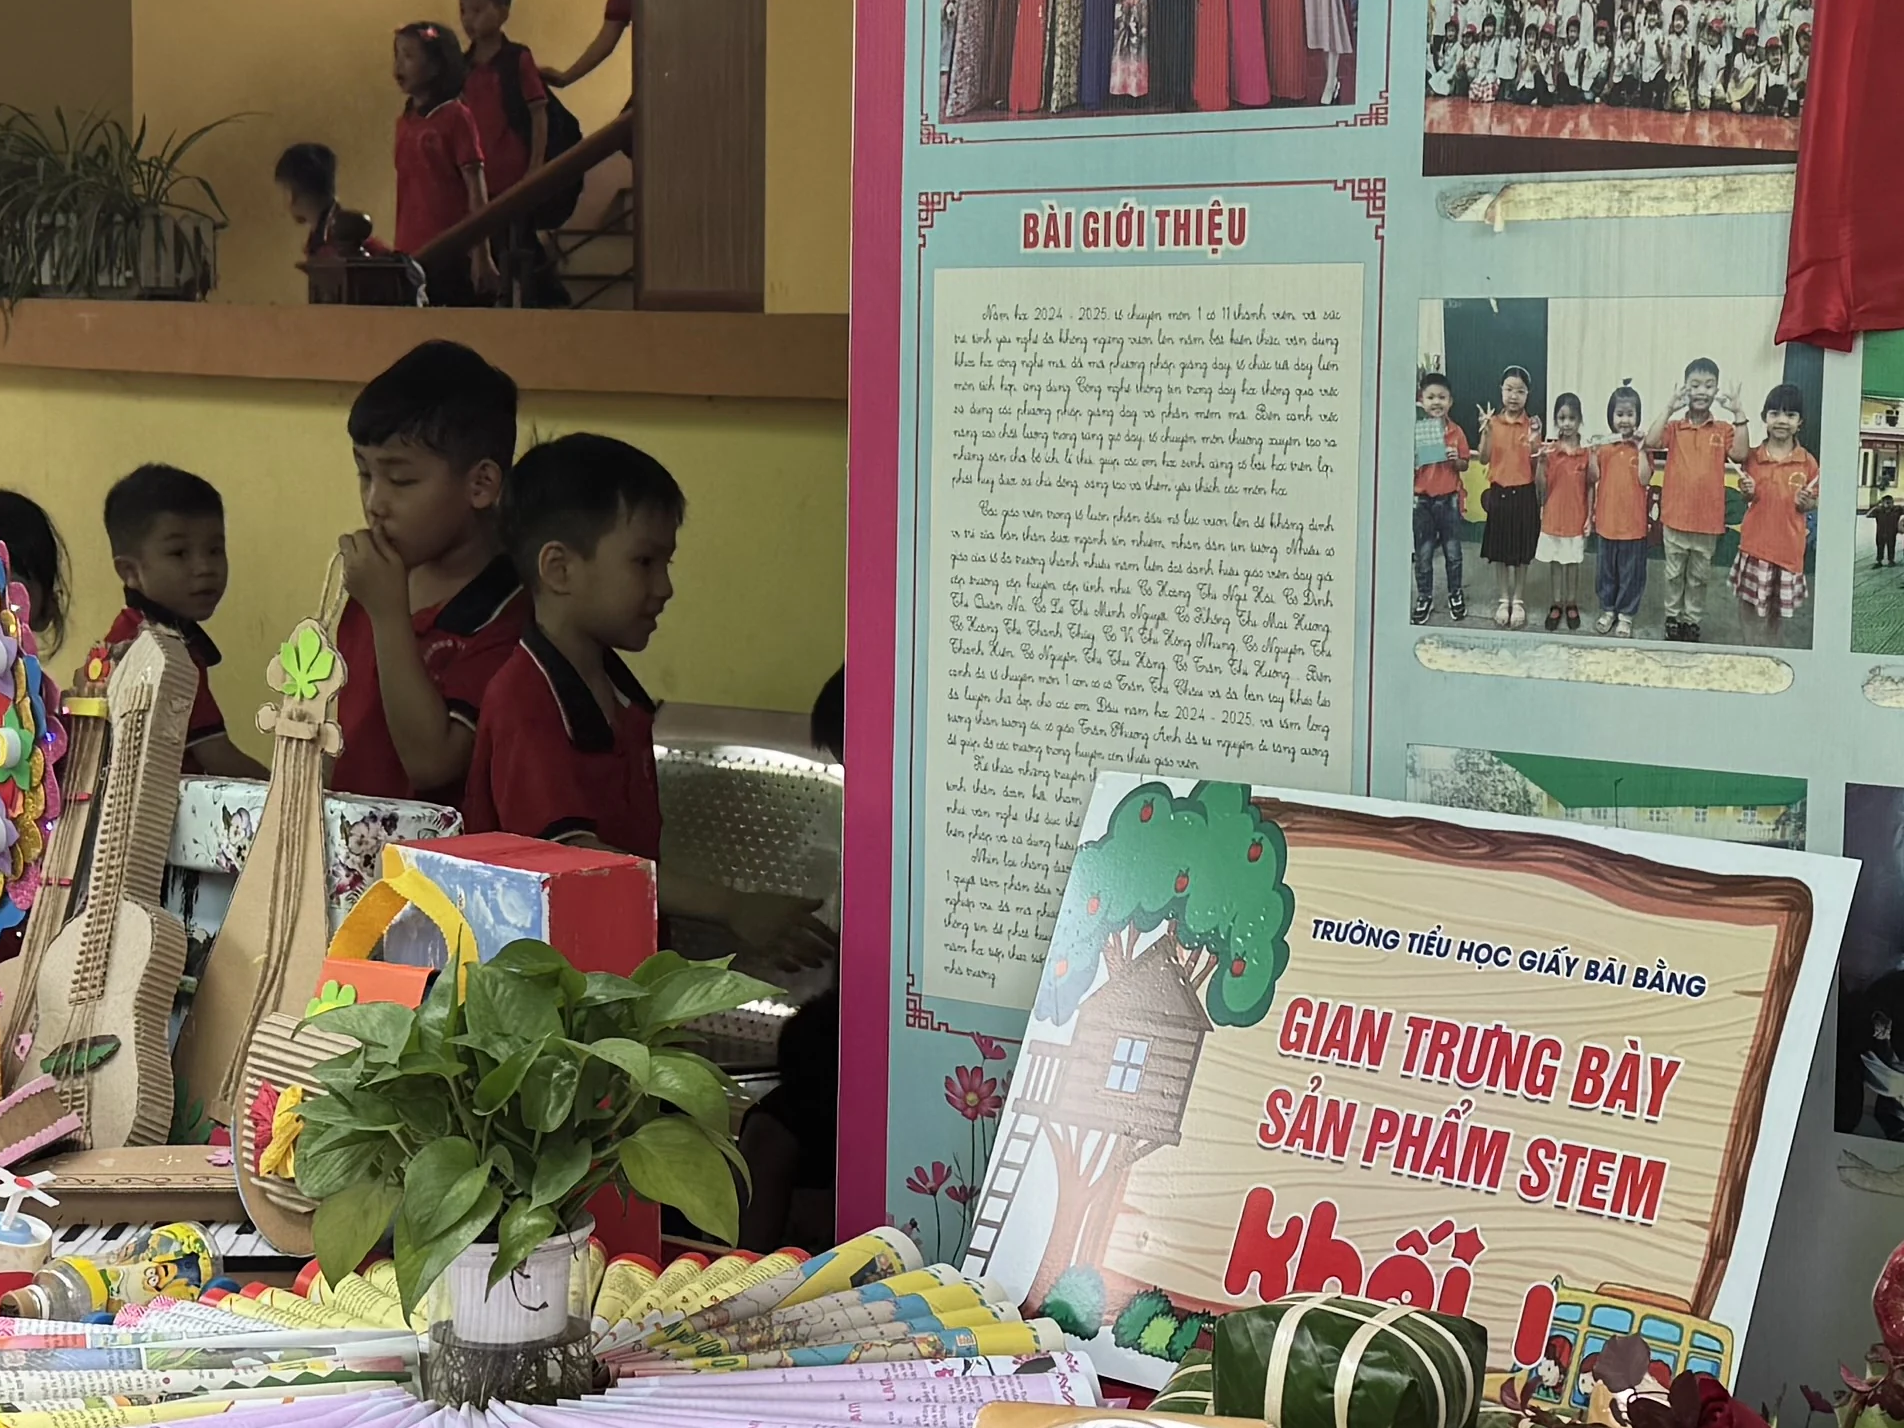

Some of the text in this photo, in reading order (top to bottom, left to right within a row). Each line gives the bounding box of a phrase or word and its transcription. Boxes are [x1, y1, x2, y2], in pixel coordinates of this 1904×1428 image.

[1023, 200, 1247, 255] BÀI GIỚI THIỆU
[1034, 307, 1063, 321] 2024
[1175, 705, 1205, 722] 2024
[1311, 917, 1708, 999] TRƯỜNG TIỂU HỌC GIẤY BÃI BẰNG
[1278, 996, 1682, 1123] GIAN TRƯNG BÀY
[1257, 1077, 1669, 1226] SẢN PHẨM STEM
